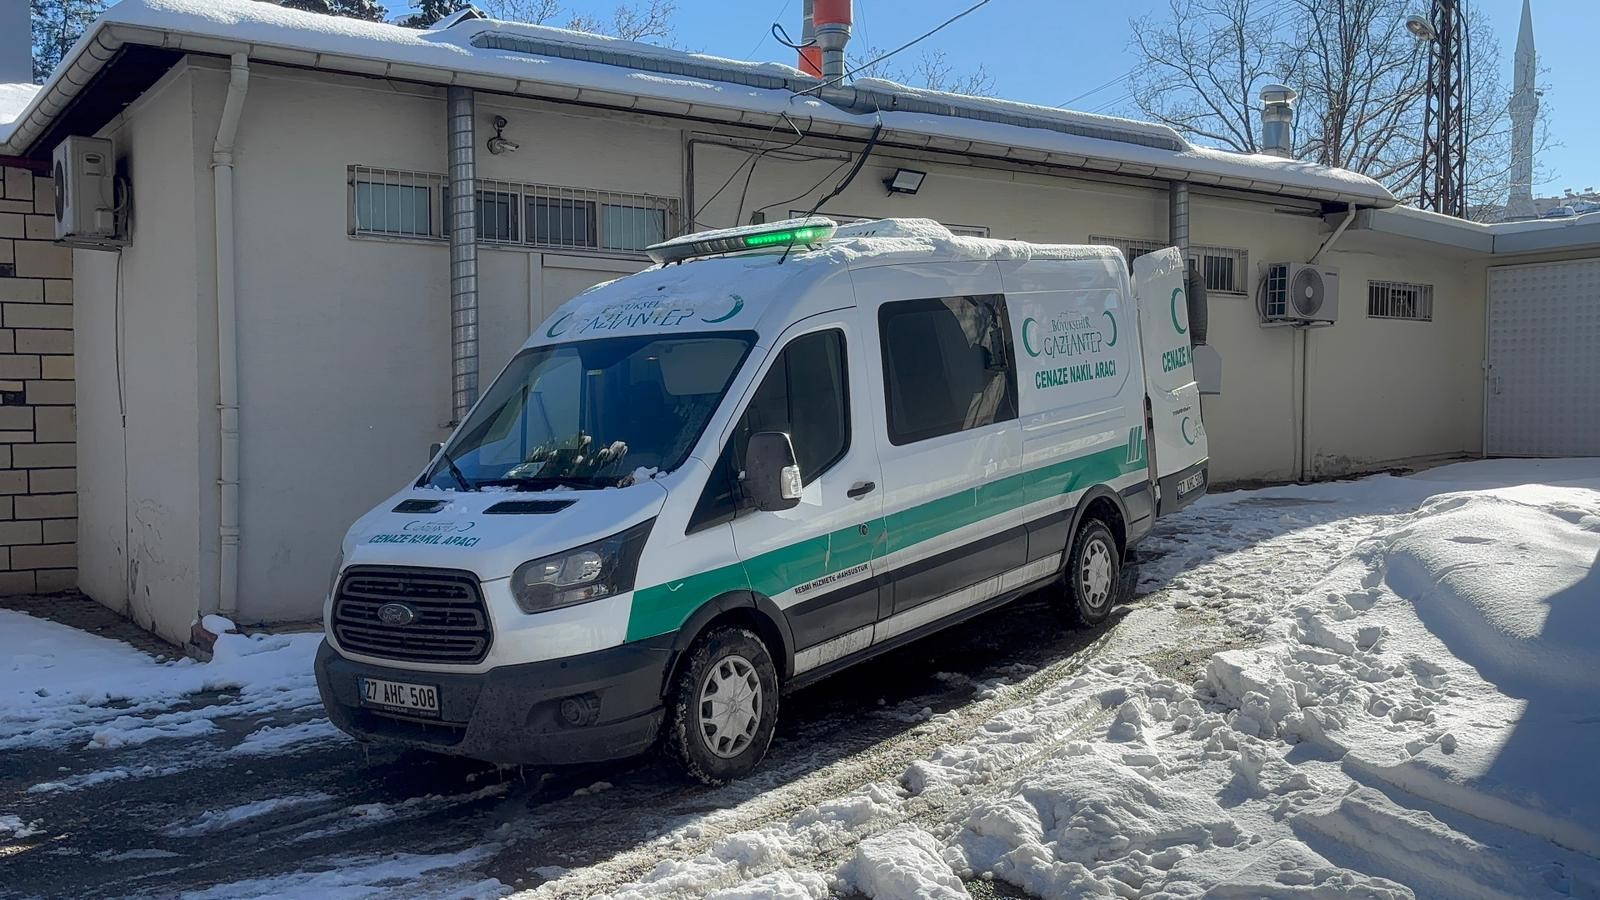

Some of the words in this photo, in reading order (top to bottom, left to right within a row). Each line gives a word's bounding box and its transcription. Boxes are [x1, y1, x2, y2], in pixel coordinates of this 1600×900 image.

[1043, 331, 1102, 358] GAZİANTEP
[1162, 346, 1186, 373] CENAZE
[1035, 367, 1068, 389] CENAZE
[1069, 360, 1094, 383] NAKİL
[1095, 360, 1116, 379] ARACI
[368, 533, 412, 544] CENAZE
[407, 533, 442, 544] NAKİL
[440, 536, 480, 547] ARACI
[365, 680, 377, 701] 27
[383, 683, 405, 705] AHC
[410, 687, 436, 708] 508
